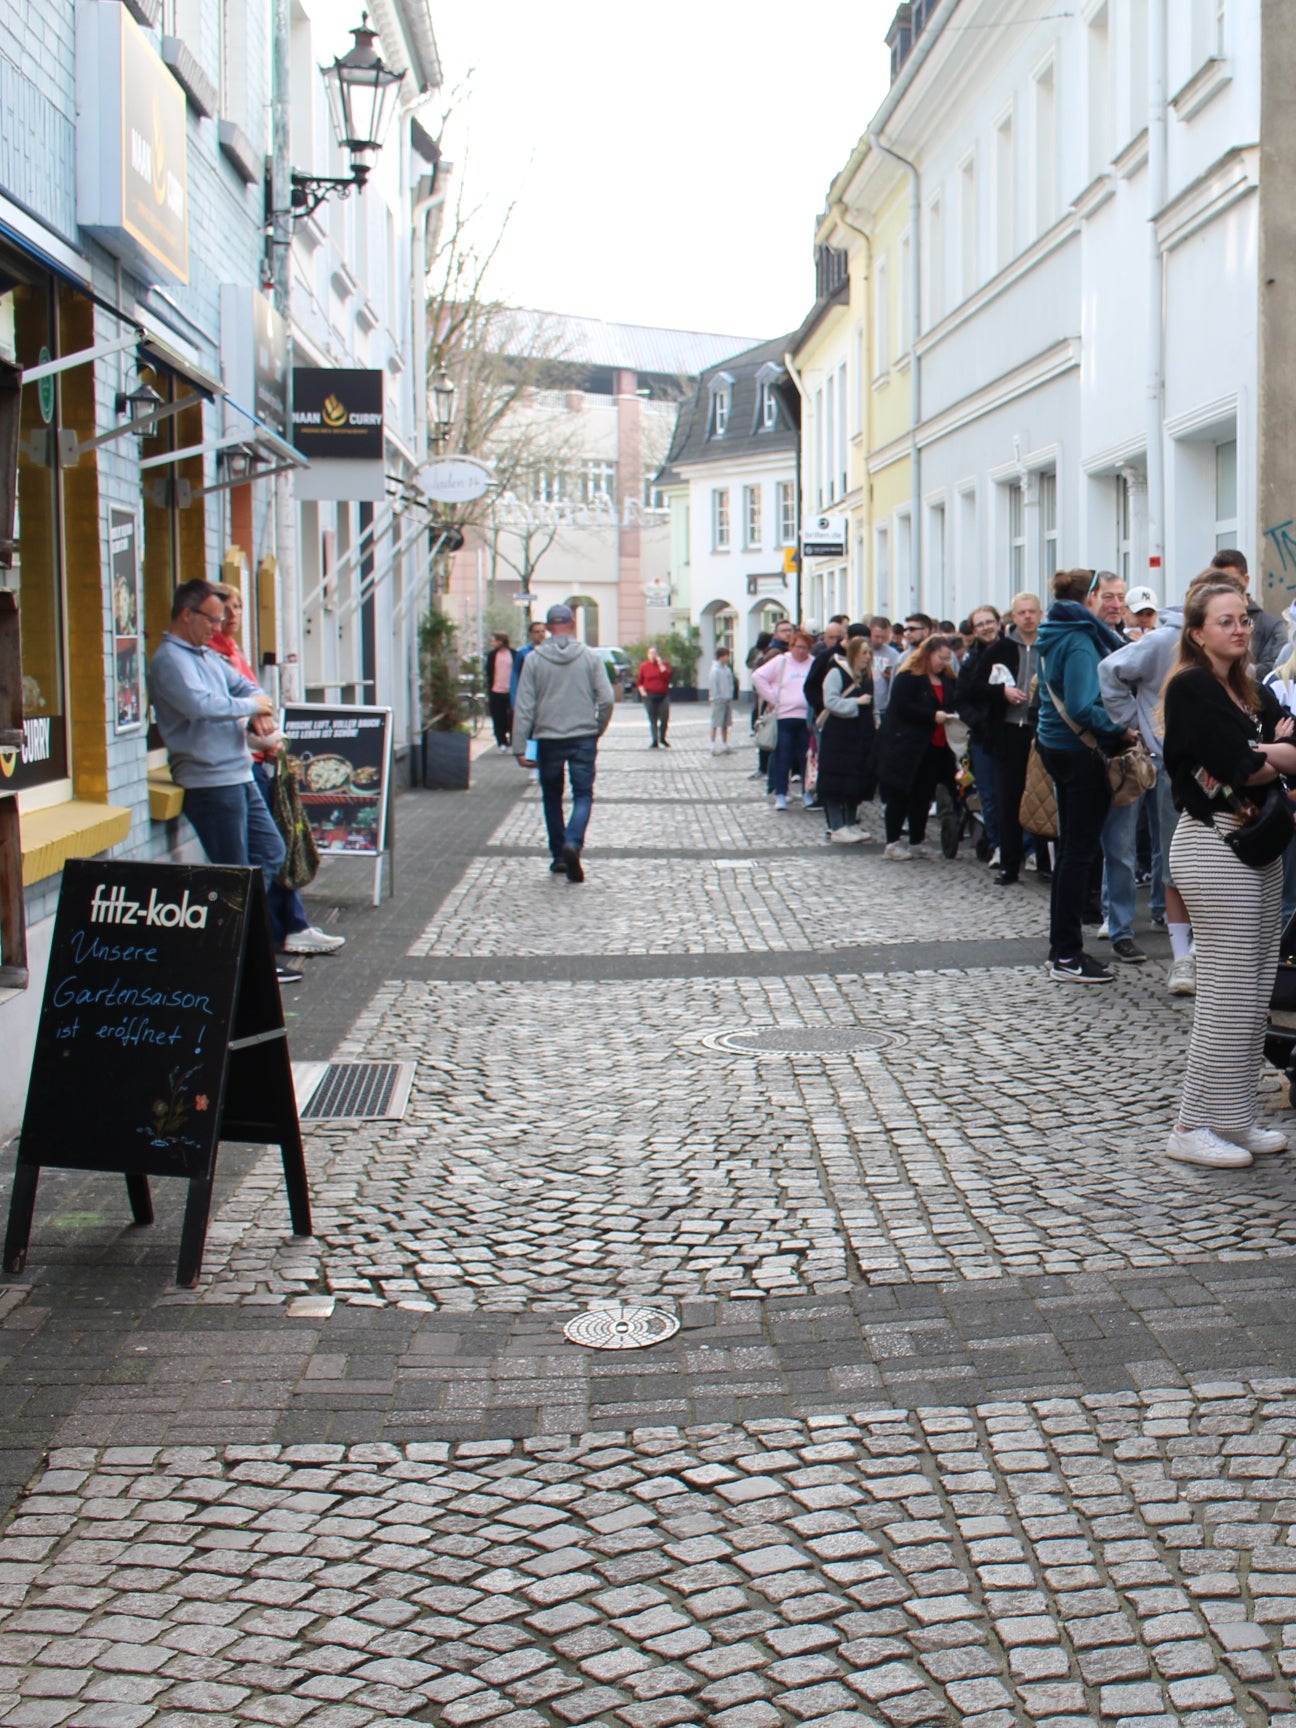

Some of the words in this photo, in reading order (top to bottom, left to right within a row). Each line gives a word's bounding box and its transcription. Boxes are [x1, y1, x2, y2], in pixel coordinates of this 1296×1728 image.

[293, 411, 321, 424] NAAN
[349, 412, 383, 425] CURRY
[22, 717, 50, 764] CURRY
[91, 884, 208, 928] fritz-kola
[71, 930, 158, 964] Unsere
[53, 976, 214, 1014] Gartensaison
[57, 1016, 80, 1039] ist
